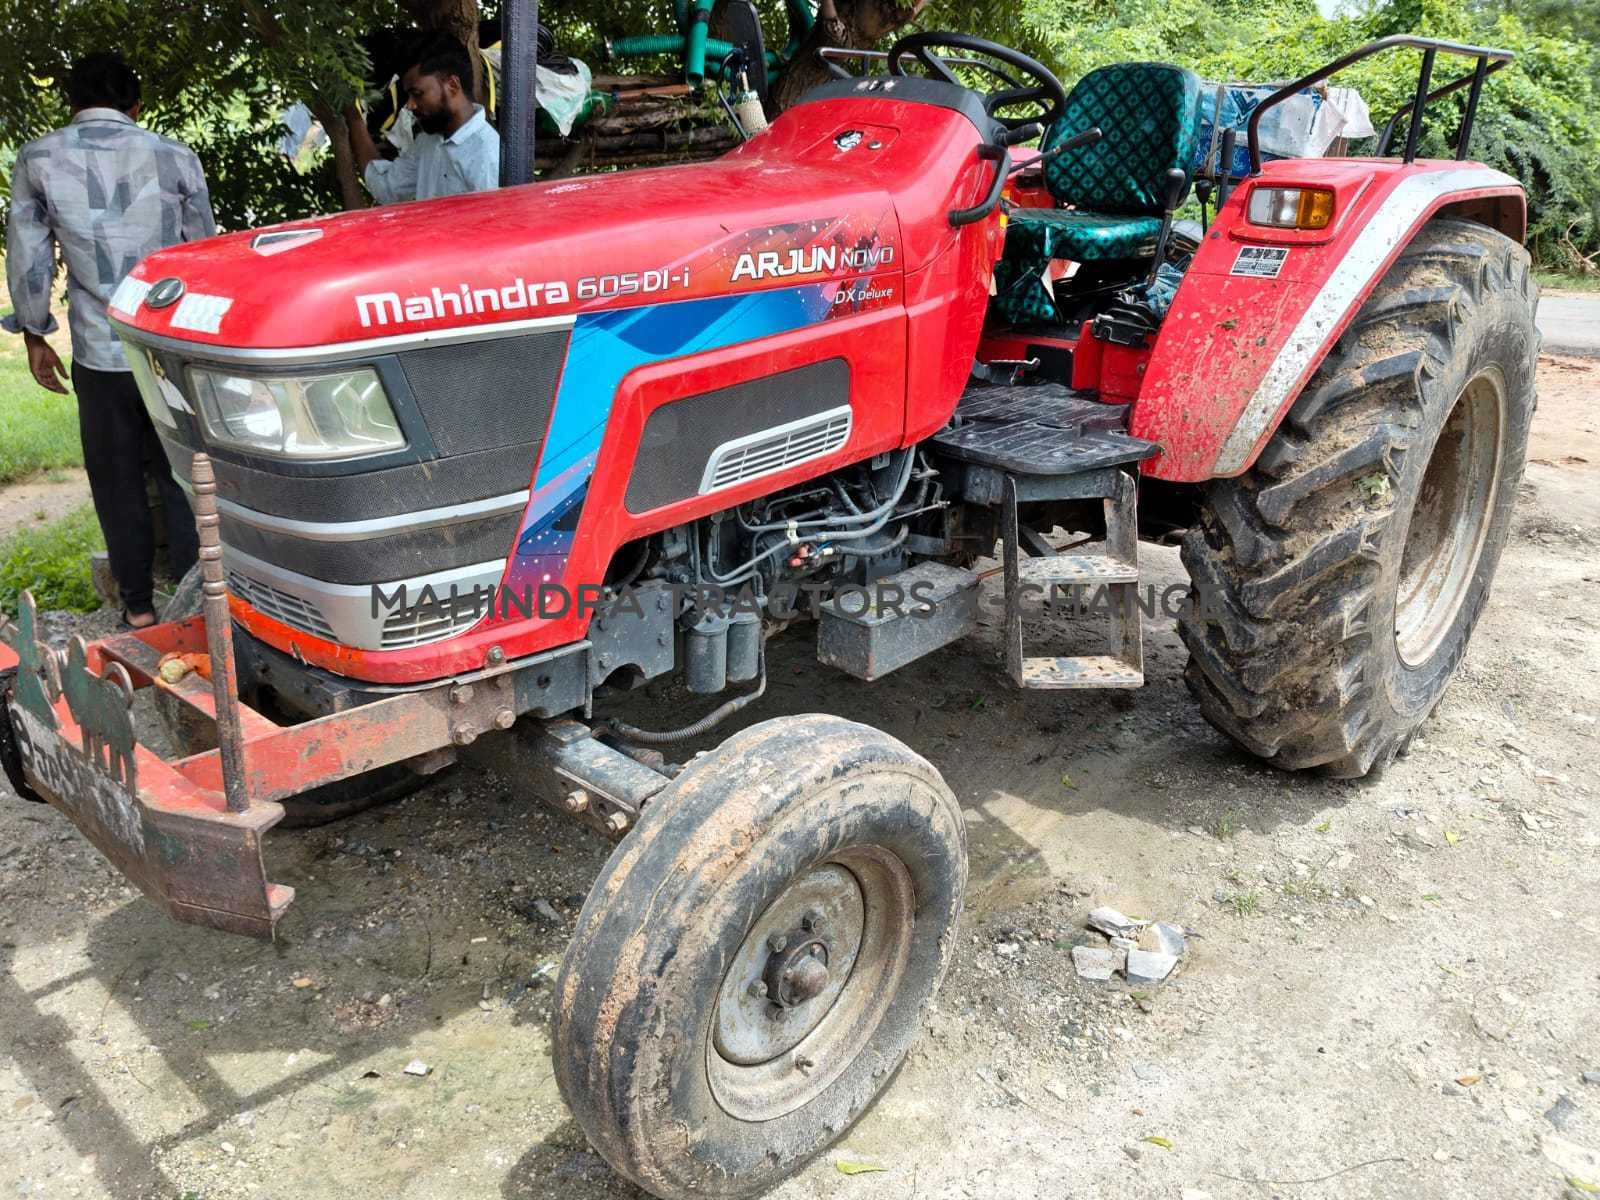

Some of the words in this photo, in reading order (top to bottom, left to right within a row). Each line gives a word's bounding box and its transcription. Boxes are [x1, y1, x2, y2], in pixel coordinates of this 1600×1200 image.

[730, 245, 836, 281] ARJUN
[840, 246, 893, 270] NOVO
[354, 278, 570, 327] Mahindra
[834, 288, 856, 304] DX
[858, 286, 893, 302] Deluxe
